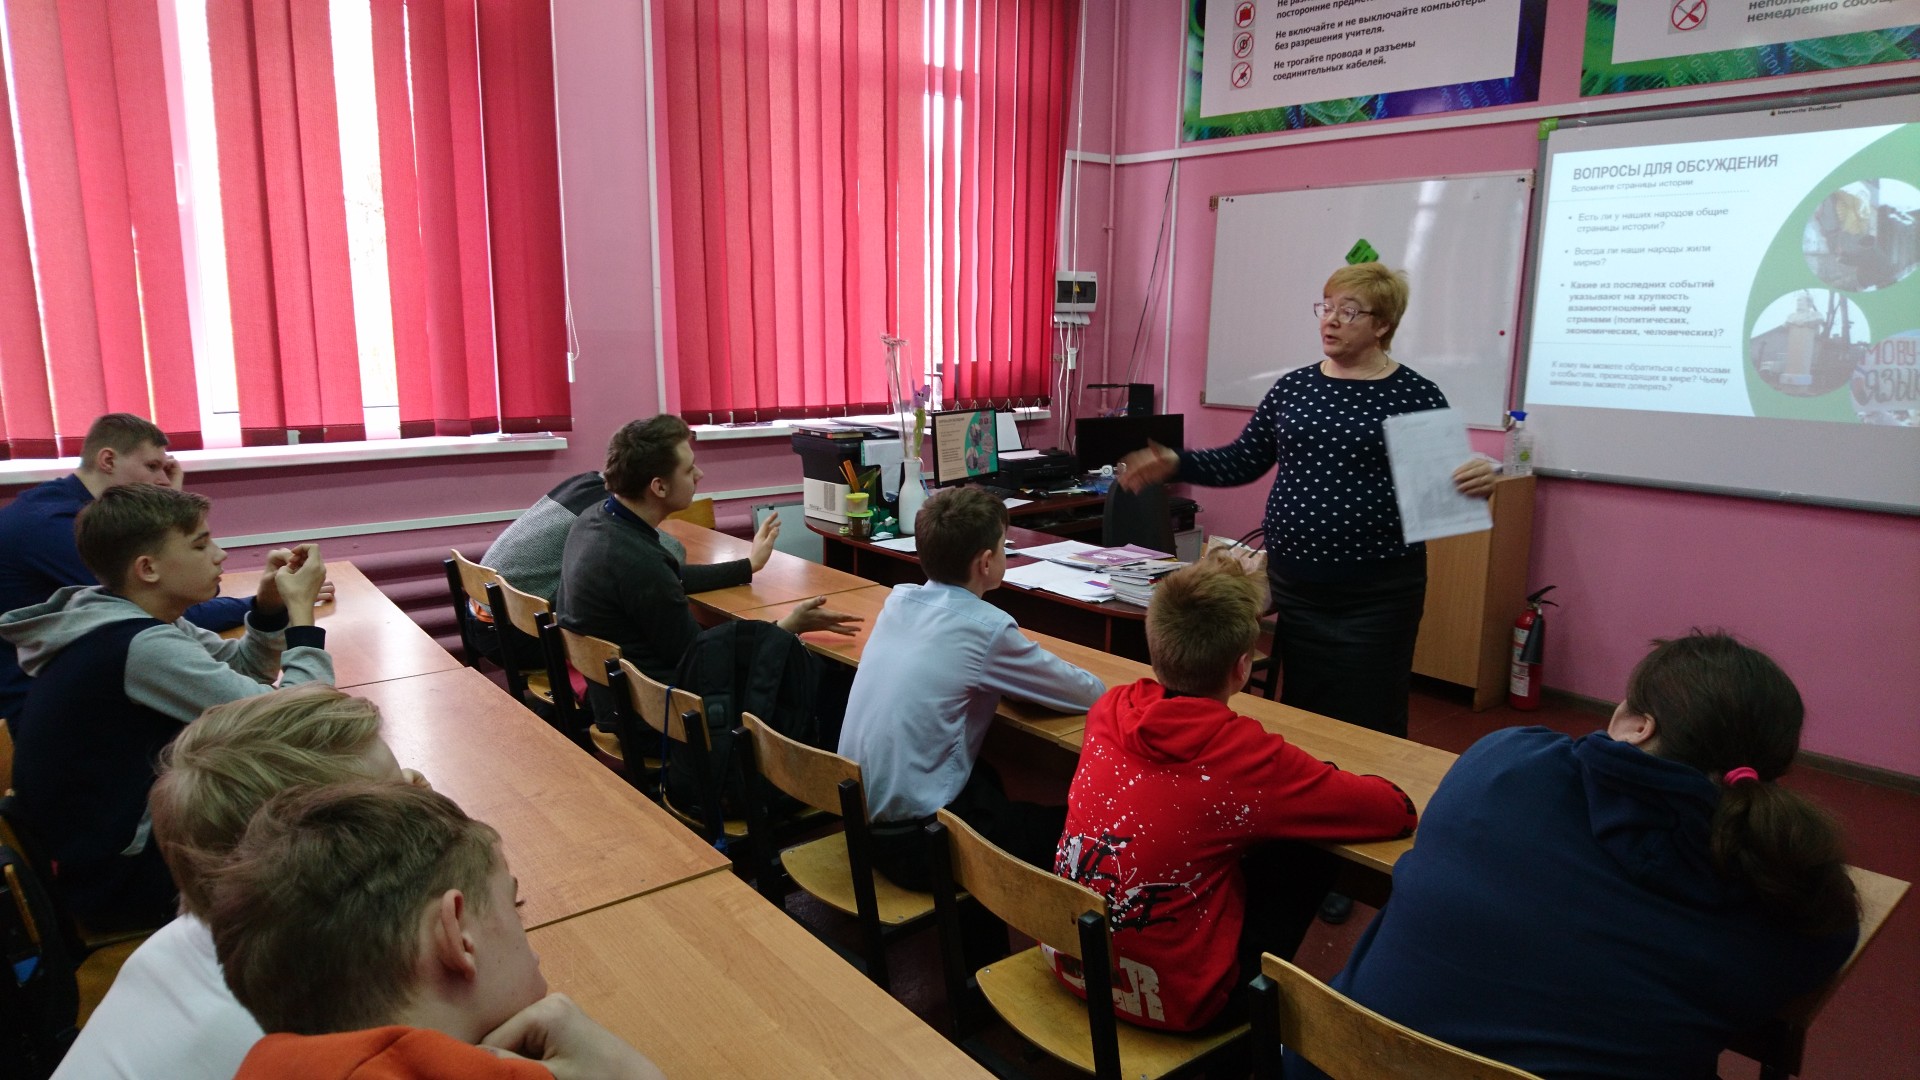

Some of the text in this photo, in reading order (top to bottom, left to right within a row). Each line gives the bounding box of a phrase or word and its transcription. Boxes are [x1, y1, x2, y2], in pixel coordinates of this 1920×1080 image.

[1276, 2, 1331, 19] посторонние
[1747, 2, 1838, 23] немедленно
[1275, 31, 1286, 39] Не
[1288, 22, 1335, 37] включайте
[1337, 20, 1343, 28] и
[1345, 18, 1357, 26] не
[1358, 6, 1419, 24] выключайте
[1274, 26, 1385, 51] без разрешения учителя.
[1273, 40, 1416, 70] Не трогайте провода и разъемы
[1273, 56, 1386, 81] соединительных кабелей.
[1573, 154, 1779, 180] ВОПРОСЫ ДЛЯ ОБСУЖДЕНИЯ
[1571, 178, 1694, 193] Вспомните страницы истории
[1578, 212, 1599, 222] Есть
[1601, 212, 1612, 221] ли
[1622, 210, 1651, 220] наших
[1654, 208, 1694, 219] народов
[1696, 206, 1729, 218] общие
[1577, 221, 1665, 234] страницы истории?
[1574, 244, 1711, 257] Всегда ли наши народы жили
[1573, 258, 1607, 268] мирно?
[1570, 278, 1715, 291] Какие из последних событий
[1568, 292, 1689, 303] указывают на хрупкость
[1568, 303, 1692, 315] взаимоотношений между
[1566, 315, 1689, 326] странами (политических,
[1565, 327, 1724, 338] экономических, человеческих)?
[1624, 362, 1673, 372] обратиться
[1682, 366, 1731, 375] вопросами
